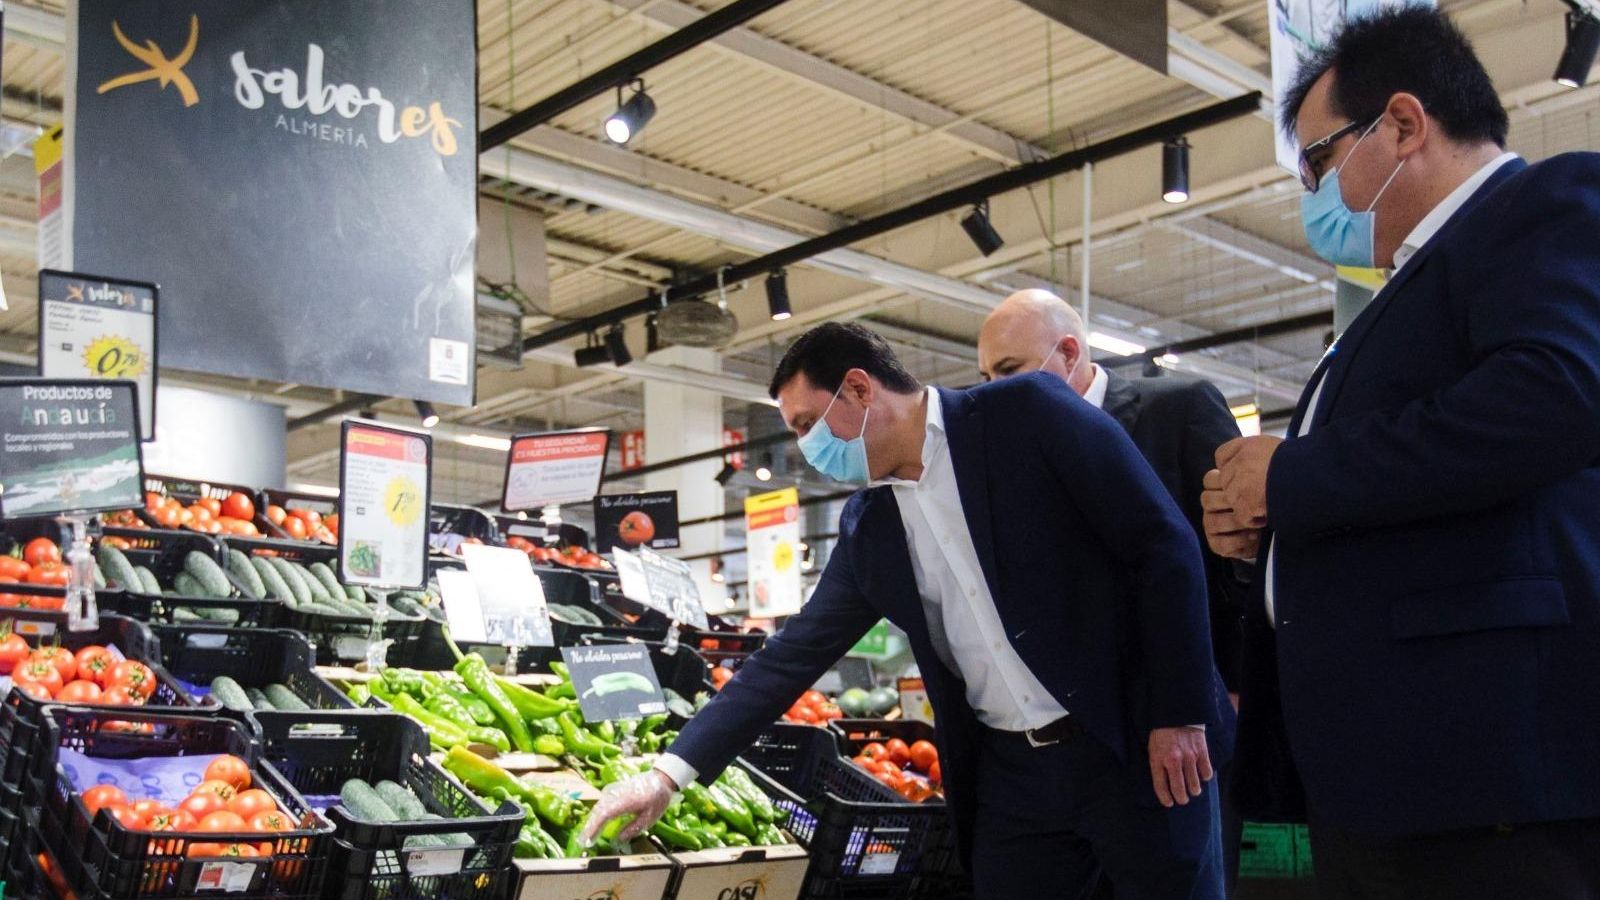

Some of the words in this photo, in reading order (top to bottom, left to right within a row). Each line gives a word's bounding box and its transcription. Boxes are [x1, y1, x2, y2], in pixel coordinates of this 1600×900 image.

[230, 43, 464, 156] sabores
[274, 114, 369, 149] ALMERÍA
[23, 386, 94, 400] Productos
[95, 386, 113, 400] de
[21, 402, 116, 426] Andalucía
